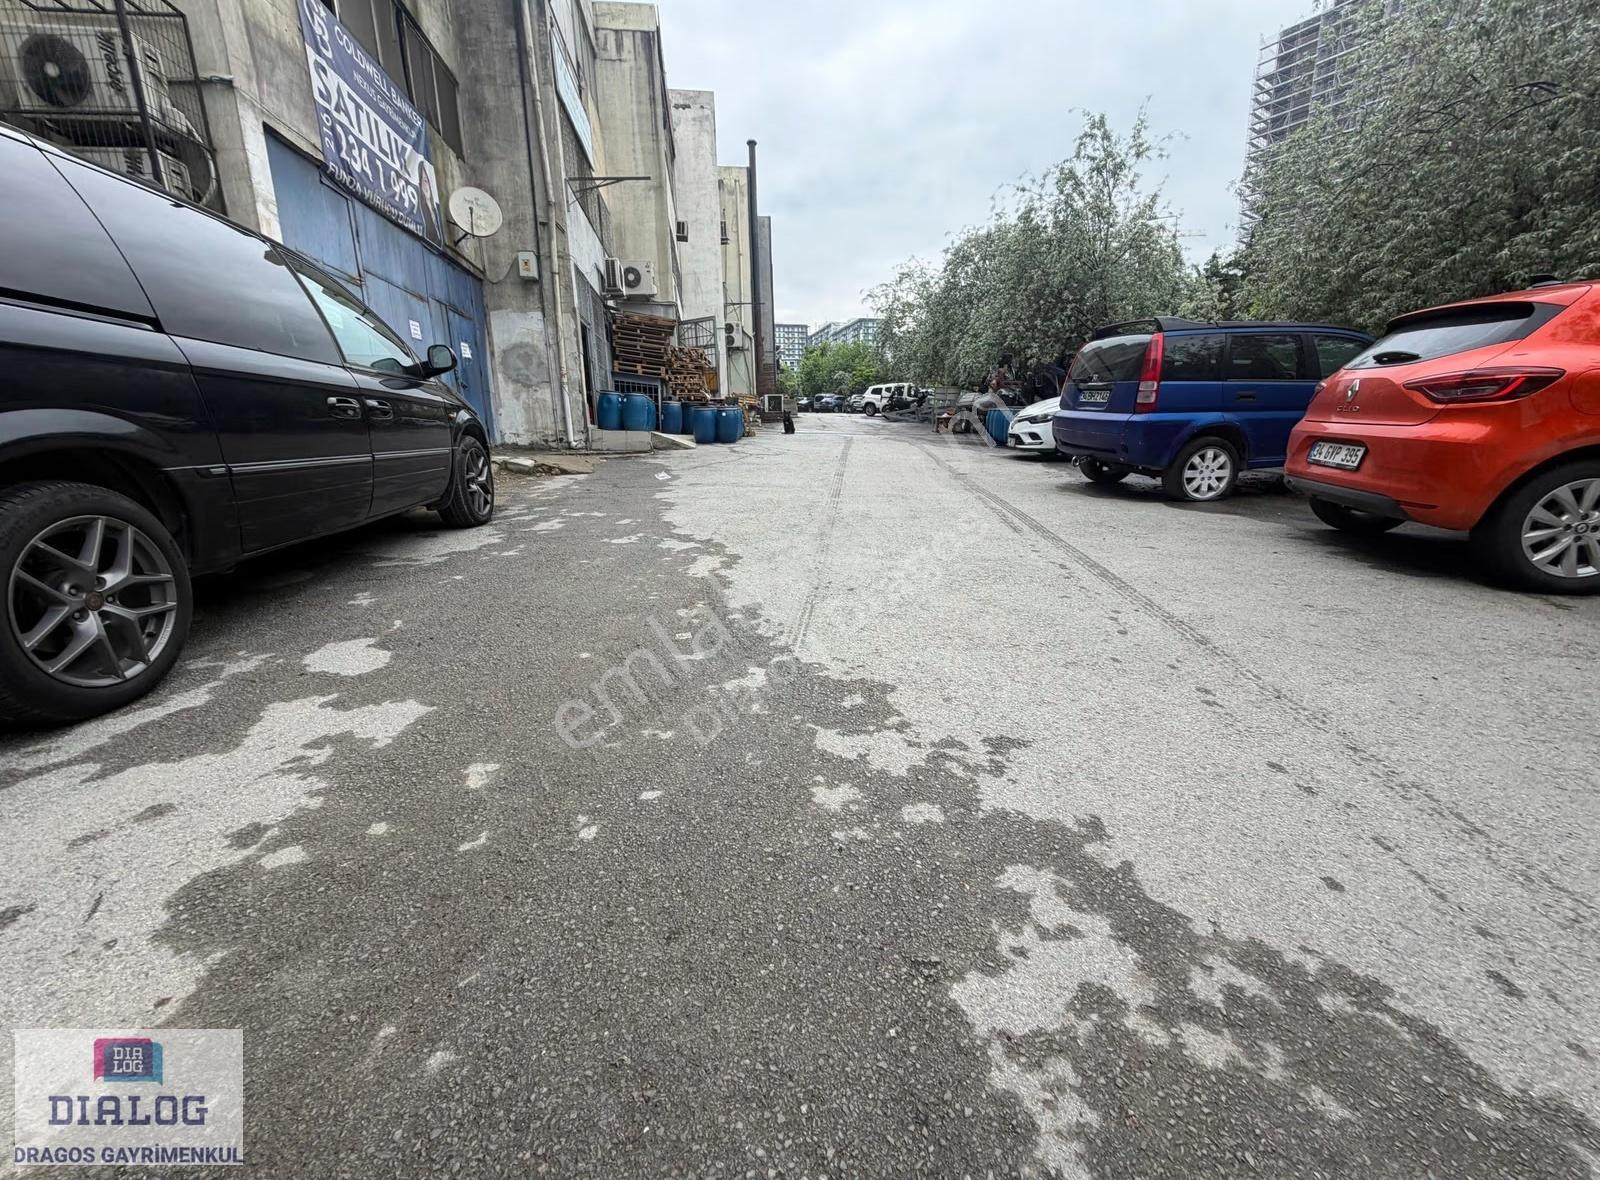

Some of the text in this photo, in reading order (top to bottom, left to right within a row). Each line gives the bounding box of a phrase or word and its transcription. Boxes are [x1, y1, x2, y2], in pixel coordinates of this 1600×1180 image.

[334, 24, 423, 127] COLDWELL BANKER
[312, 57, 413, 179] SATILIK
[320, 111, 336, 152] 216
[327, 161, 363, 195] FUNDA
[335, 123, 418, 217] 234 1 999
[1313, 443, 1326, 459] 34
[1341, 447, 1361, 464] 395
